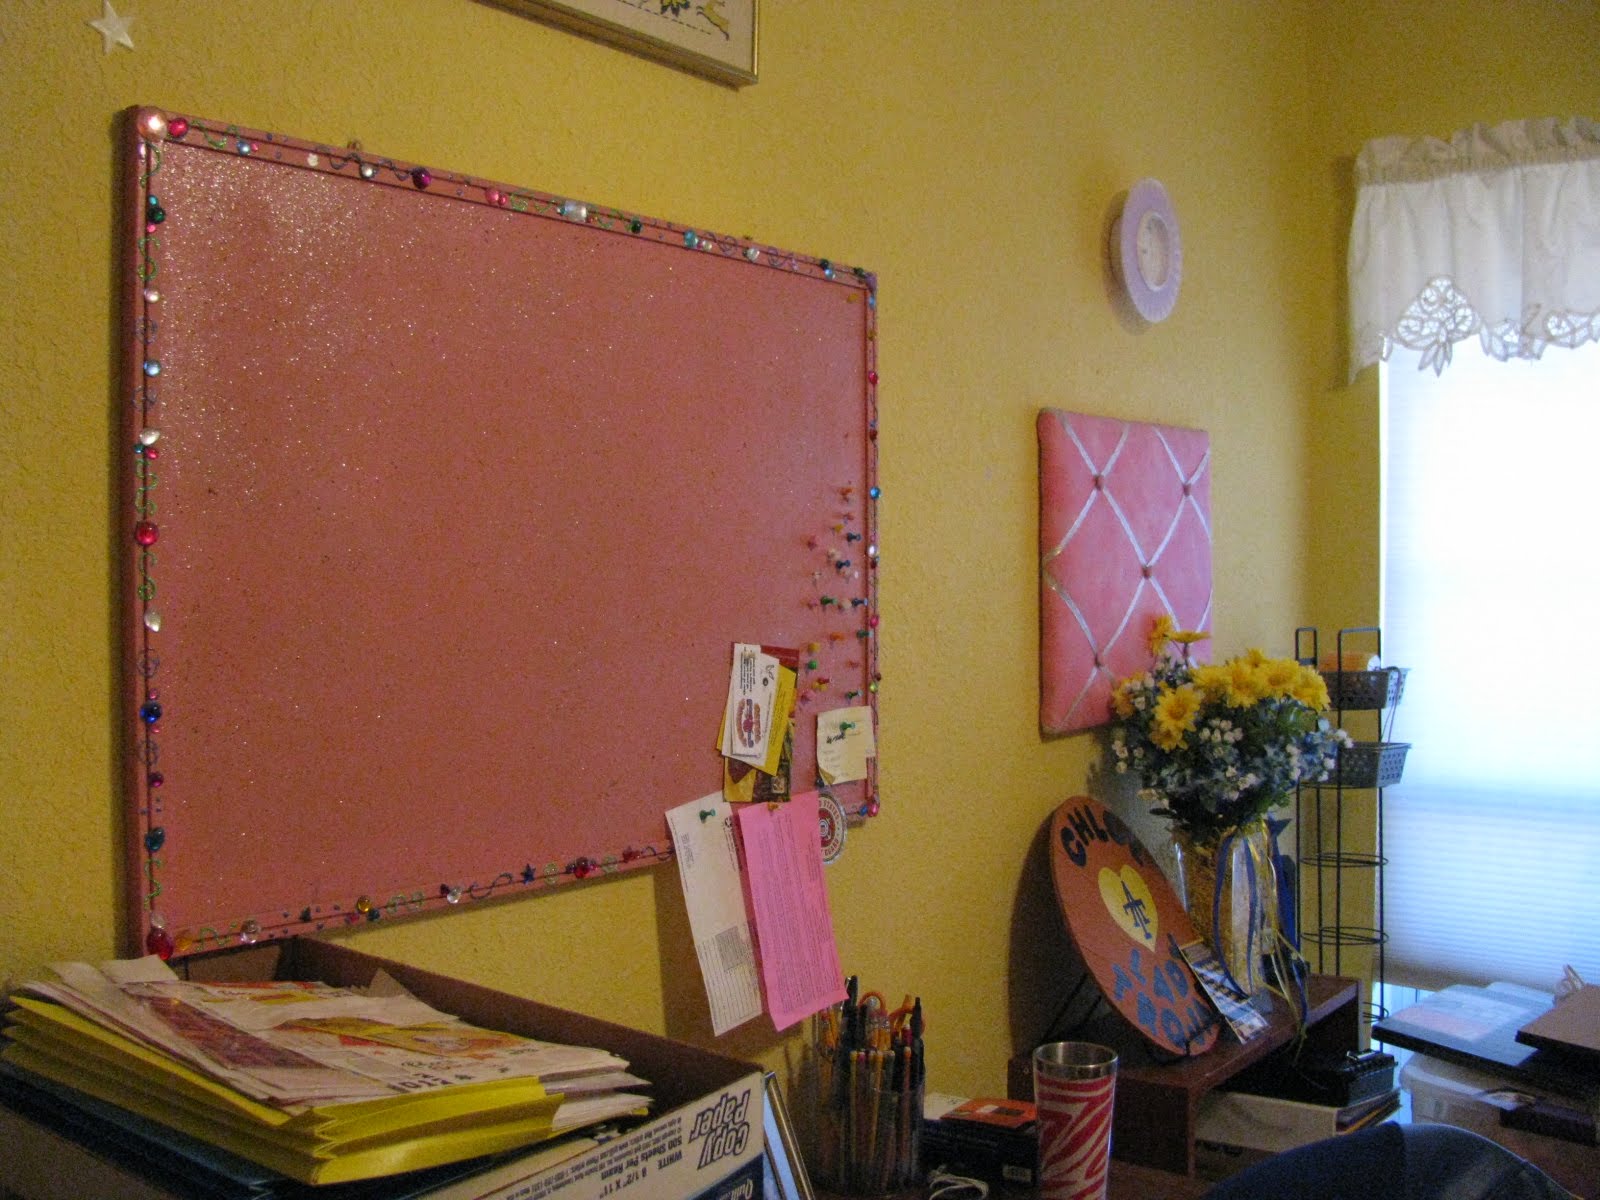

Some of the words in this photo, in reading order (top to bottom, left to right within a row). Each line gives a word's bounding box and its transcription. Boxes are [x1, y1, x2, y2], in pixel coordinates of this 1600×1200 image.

[688, 1089, 751, 1144] Paper
[640, 1143, 666, 1162] Sheets
[668, 1136, 682, 1150] 500
[697, 1121, 750, 1170] Copy
[626, 1155, 639, 1169] Per
[658, 1150, 682, 1170] WHITE
